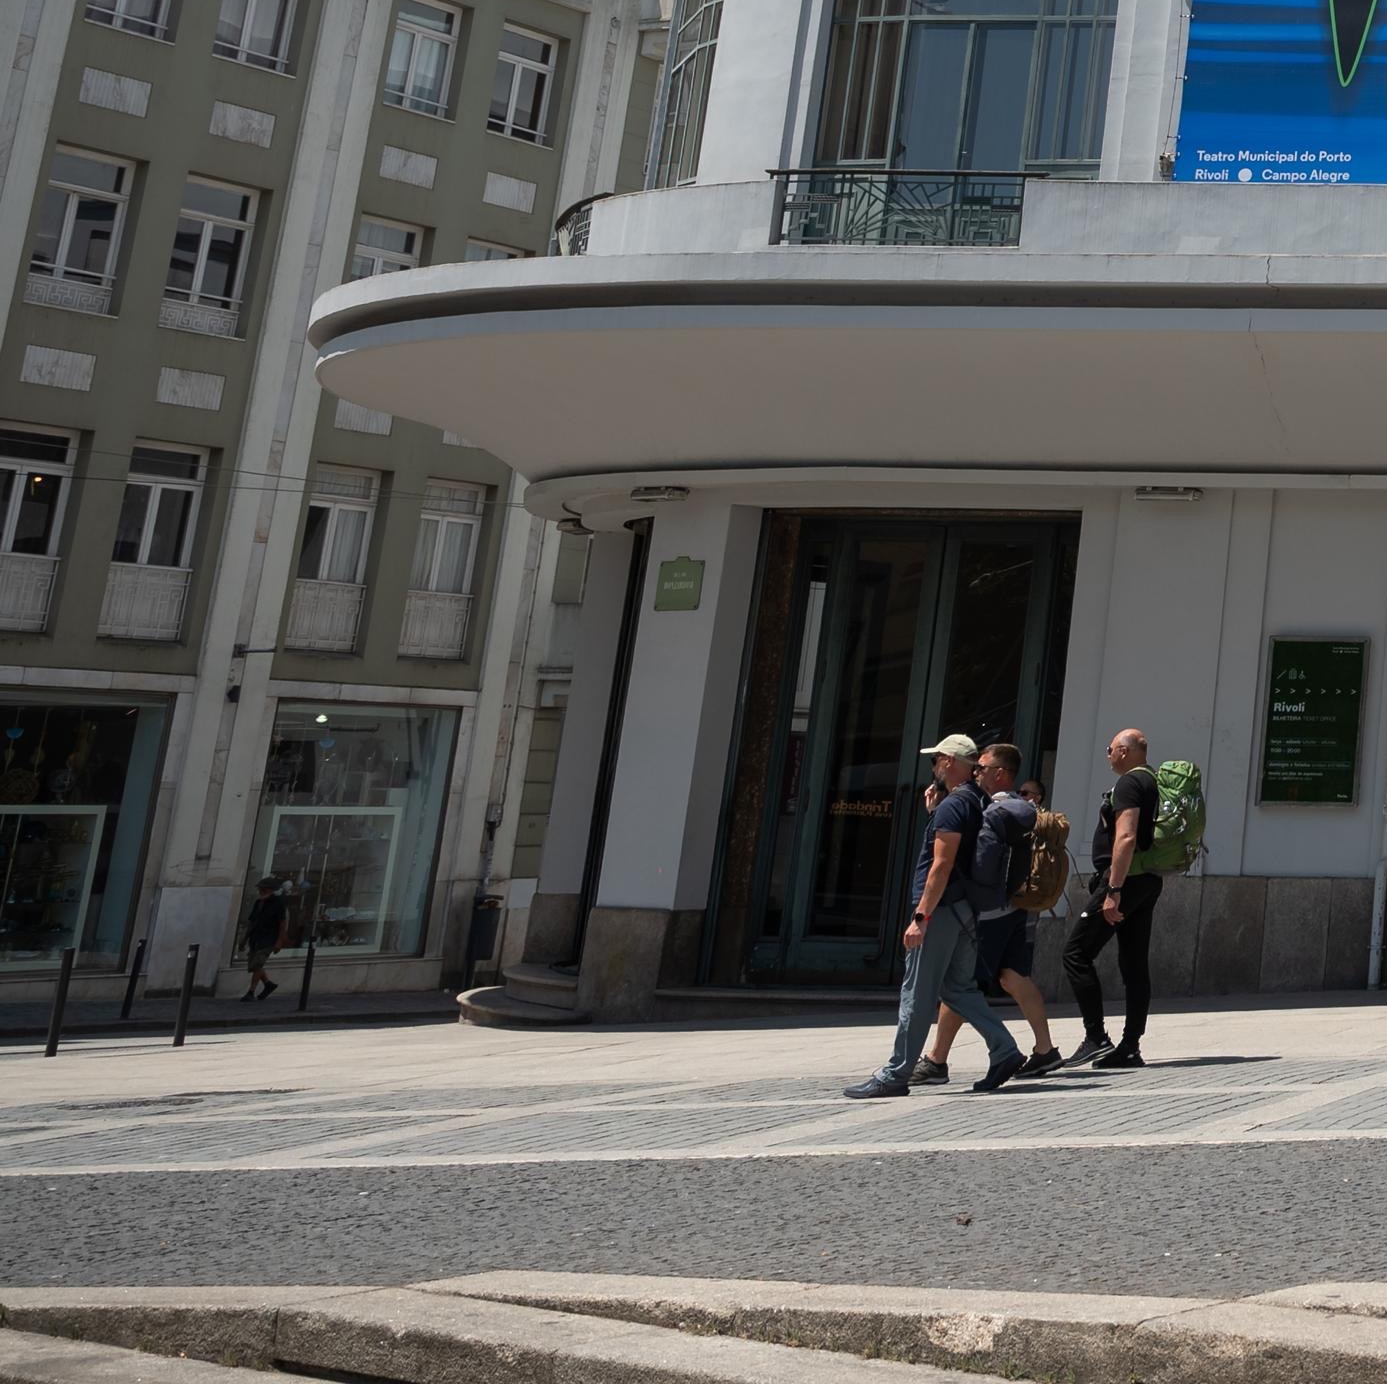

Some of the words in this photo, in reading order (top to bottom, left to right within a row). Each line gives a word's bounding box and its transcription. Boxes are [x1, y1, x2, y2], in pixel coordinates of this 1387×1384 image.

[1197, 150, 1235, 162] Teatro
[1238, 150, 1297, 164] Municipal
[1300, 150, 1315, 162] do
[1318, 151, 1351, 162] Porto
[1195, 169, 1229, 180] Rivoli
[1262, 170, 1307, 182] Campo
[1310, 170, 1350, 182] Alegre
[1274, 702, 1305, 712] Rivoli
